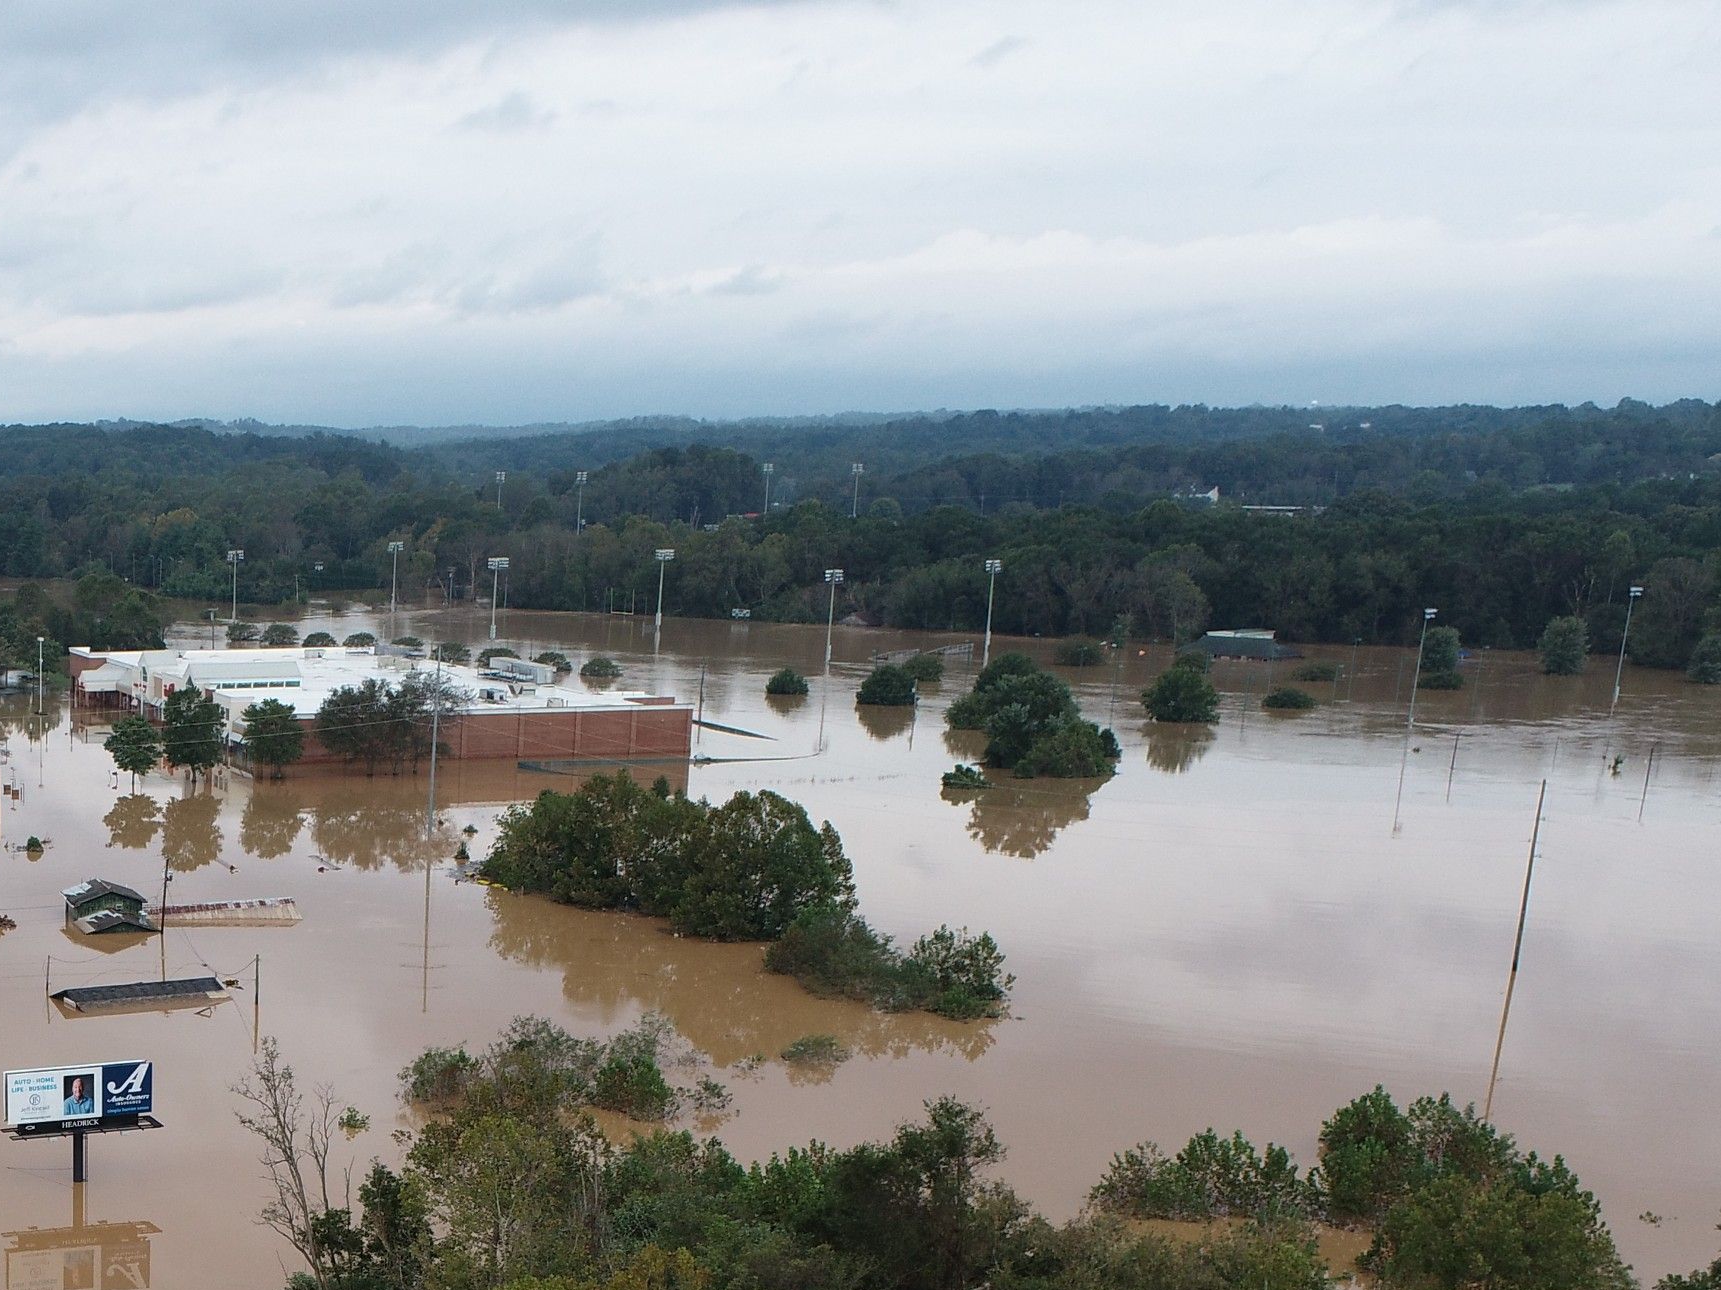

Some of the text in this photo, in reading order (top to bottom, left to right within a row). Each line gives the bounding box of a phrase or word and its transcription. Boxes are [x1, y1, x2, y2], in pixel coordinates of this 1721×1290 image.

[28, 1084, 57, 1092] BUSINESS
[107, 1094, 149, 1103] Auto-Owners
[62, 1118, 100, 1128] HEADRICK
